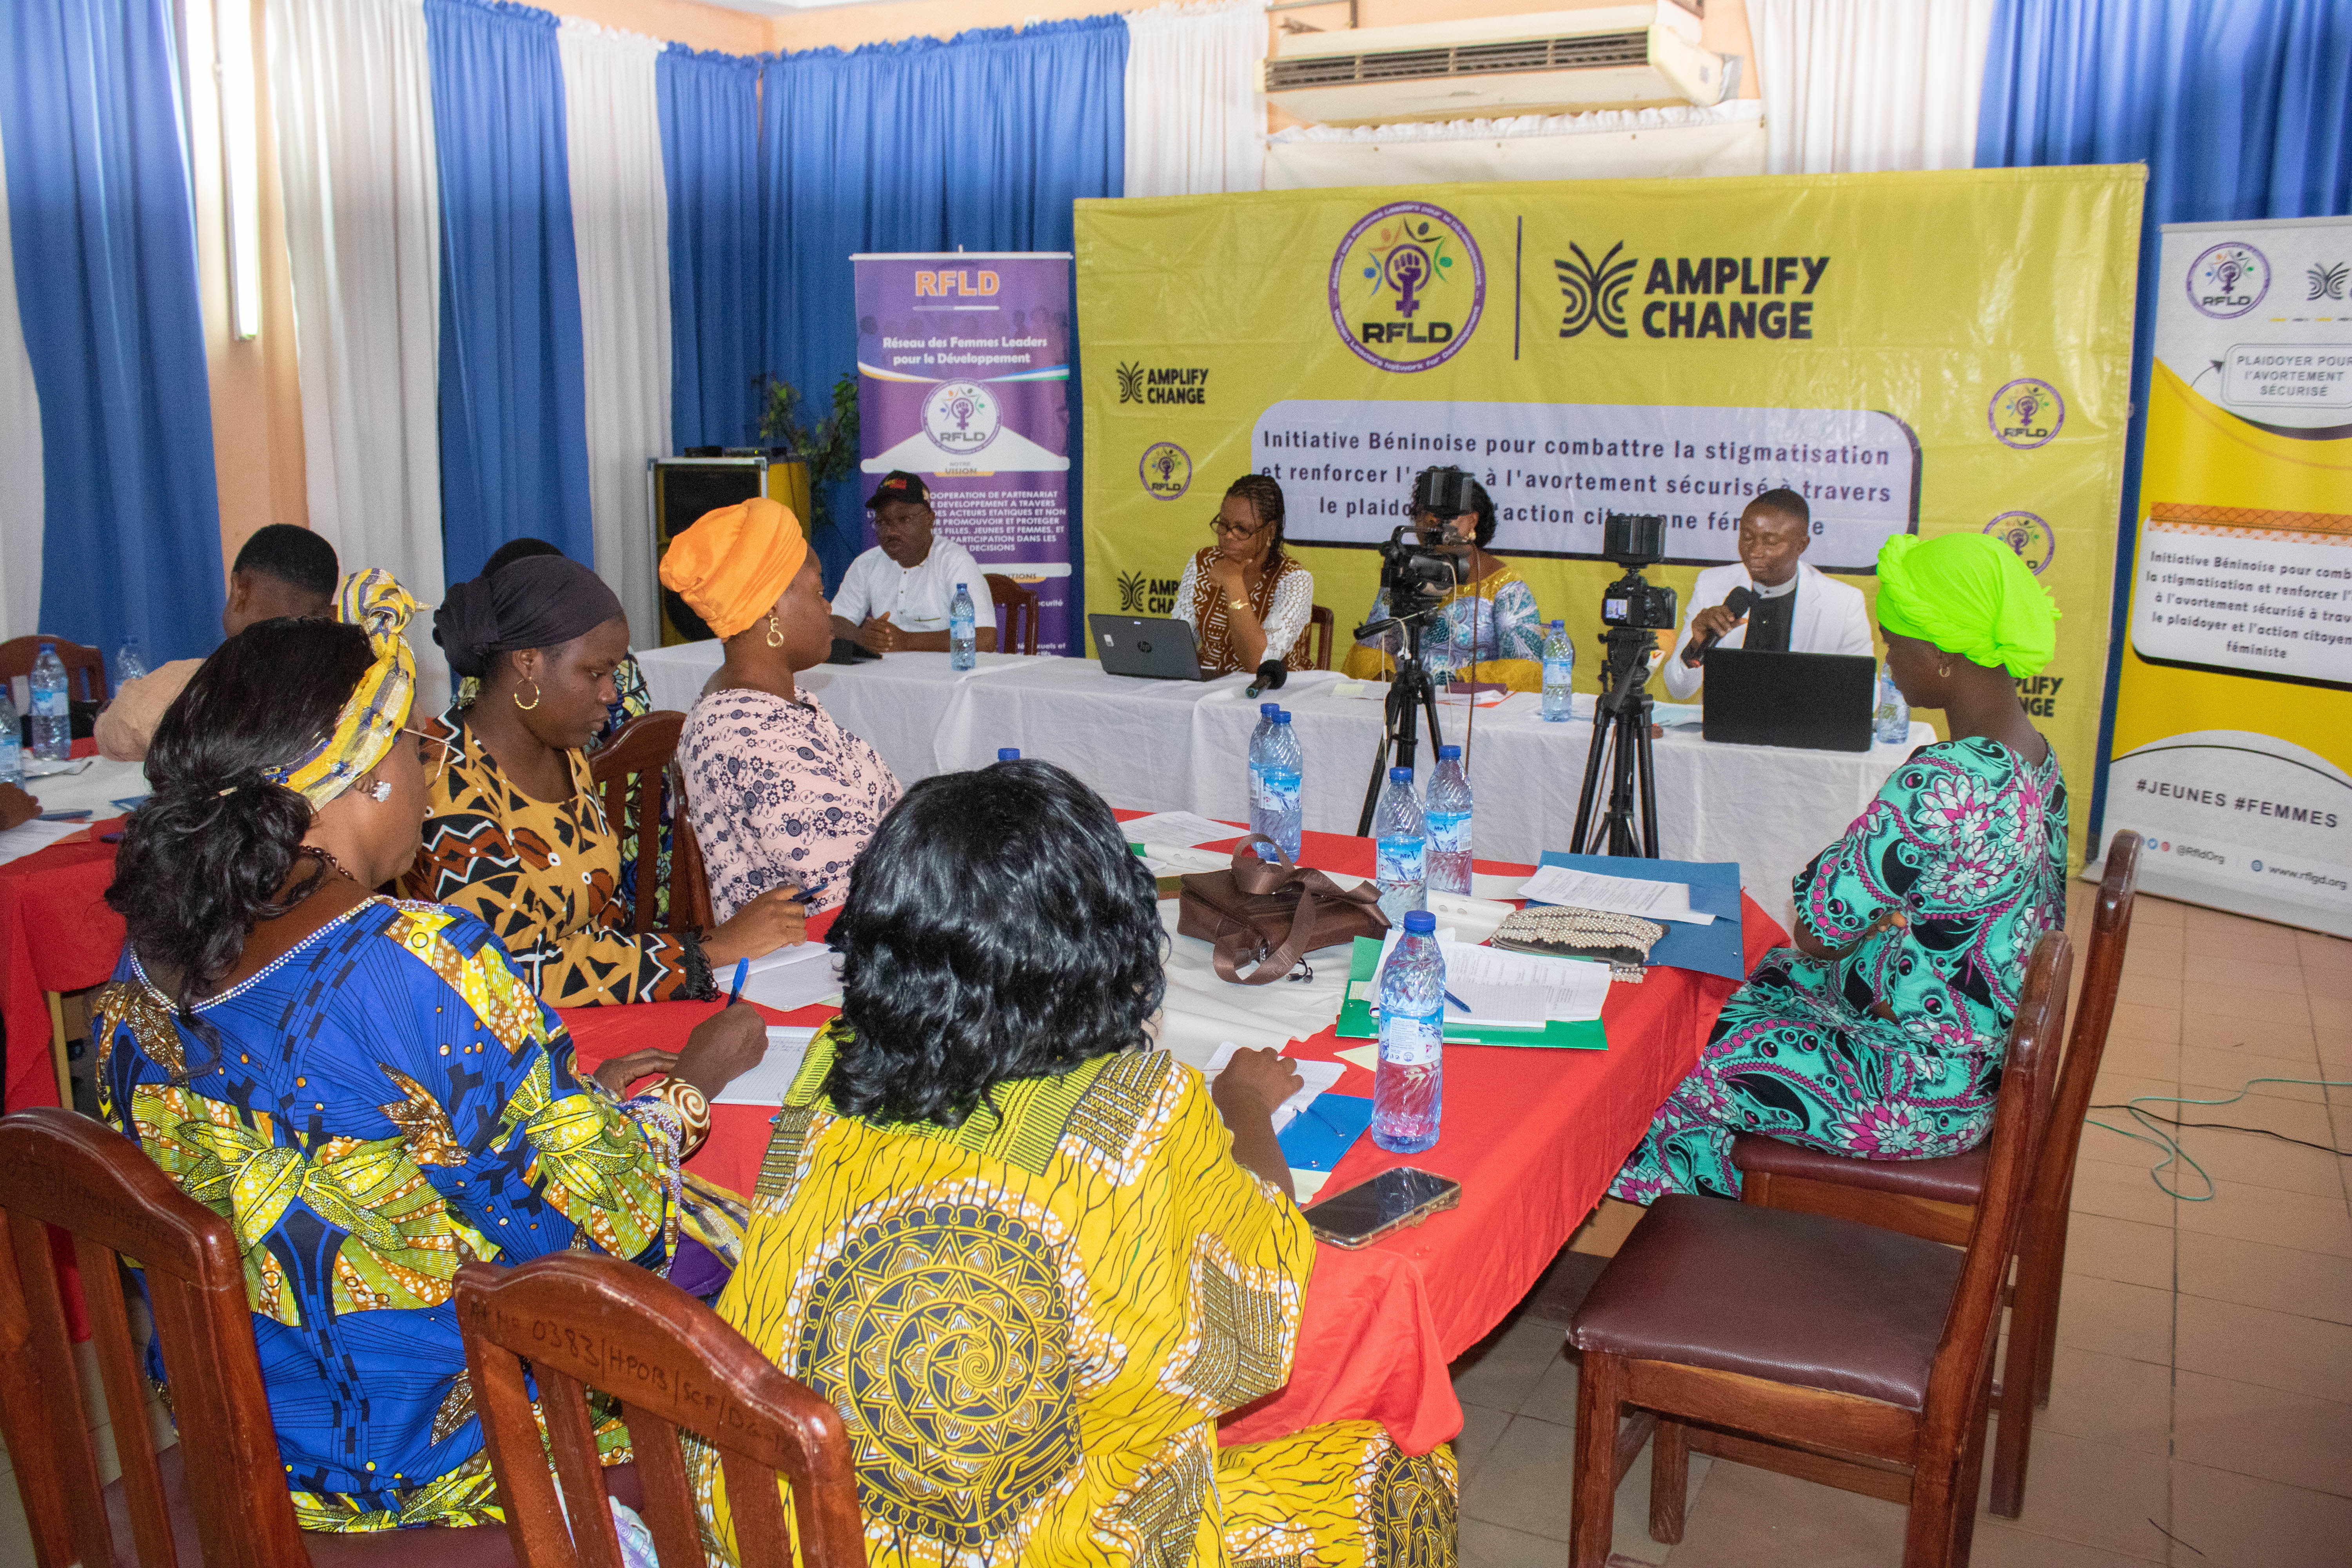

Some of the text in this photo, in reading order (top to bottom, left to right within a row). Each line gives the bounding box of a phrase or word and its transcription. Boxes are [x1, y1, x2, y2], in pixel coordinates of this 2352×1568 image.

[915, 270, 1000, 296] RFLD
[1644, 257, 1830, 295] AMPLIFY
[2203, 296, 2251, 306] RFLD
[1642, 301, 1813, 339] CHANGE
[883, 337, 1047, 348] Réseau des Femmes Leaders
[1363, 322, 1453, 343] RFLD
[893, 353, 1030, 366] pour le Développement
[2236, 356, 2312, 365] PLAIDOYER
[1147, 368, 1208, 385] AMPLIFY
[1147, 388, 1205, 404] CHANGE
[2260, 385, 2328, 396] SÉCURISÉ
[940, 432, 985, 442] RFLD
[1264, 431, 1889, 465] Initiative Béninoise pour combattre la stigmatisation
[1262, 463, 1281, 480] et
[1290, 464, 1387, 483] renforcer
[1486, 468, 1496, 486] à
[1507, 470, 1656, 494] l'avortement
[1666, 475, 1768, 496] sécurisé
[1803, 480, 1891, 502] travers
[1320, 497, 1412, 518] le plaido
[2151, 551, 2209, 566] Initiative
[2214, 556, 2275, 573] Béninoise
[2280, 565, 2311, 575] pour
[2146, 571, 2157, 582] la
[2162, 573, 2252, 592] stigmatisation
[2258, 584, 2270, 593] et
[2276, 586, 2338, 601] renforcer
[2155, 592, 2162, 603] à
[2167, 593, 2248, 612] l'avortement
[2253, 604, 2305, 618] sécurisé
[2309, 608, 2317, 619] à
[2152, 611, 2162, 622] le
[2167, 614, 2228, 631] plaidoyer
[2232, 622, 2244, 633] et
[2249, 622, 2298, 639] l'action
[2227, 640, 2287, 658] féministe
[2015, 676, 2063, 695] PLIFY
[2136, 779, 2338, 828] #JEUNES #FEMMES
